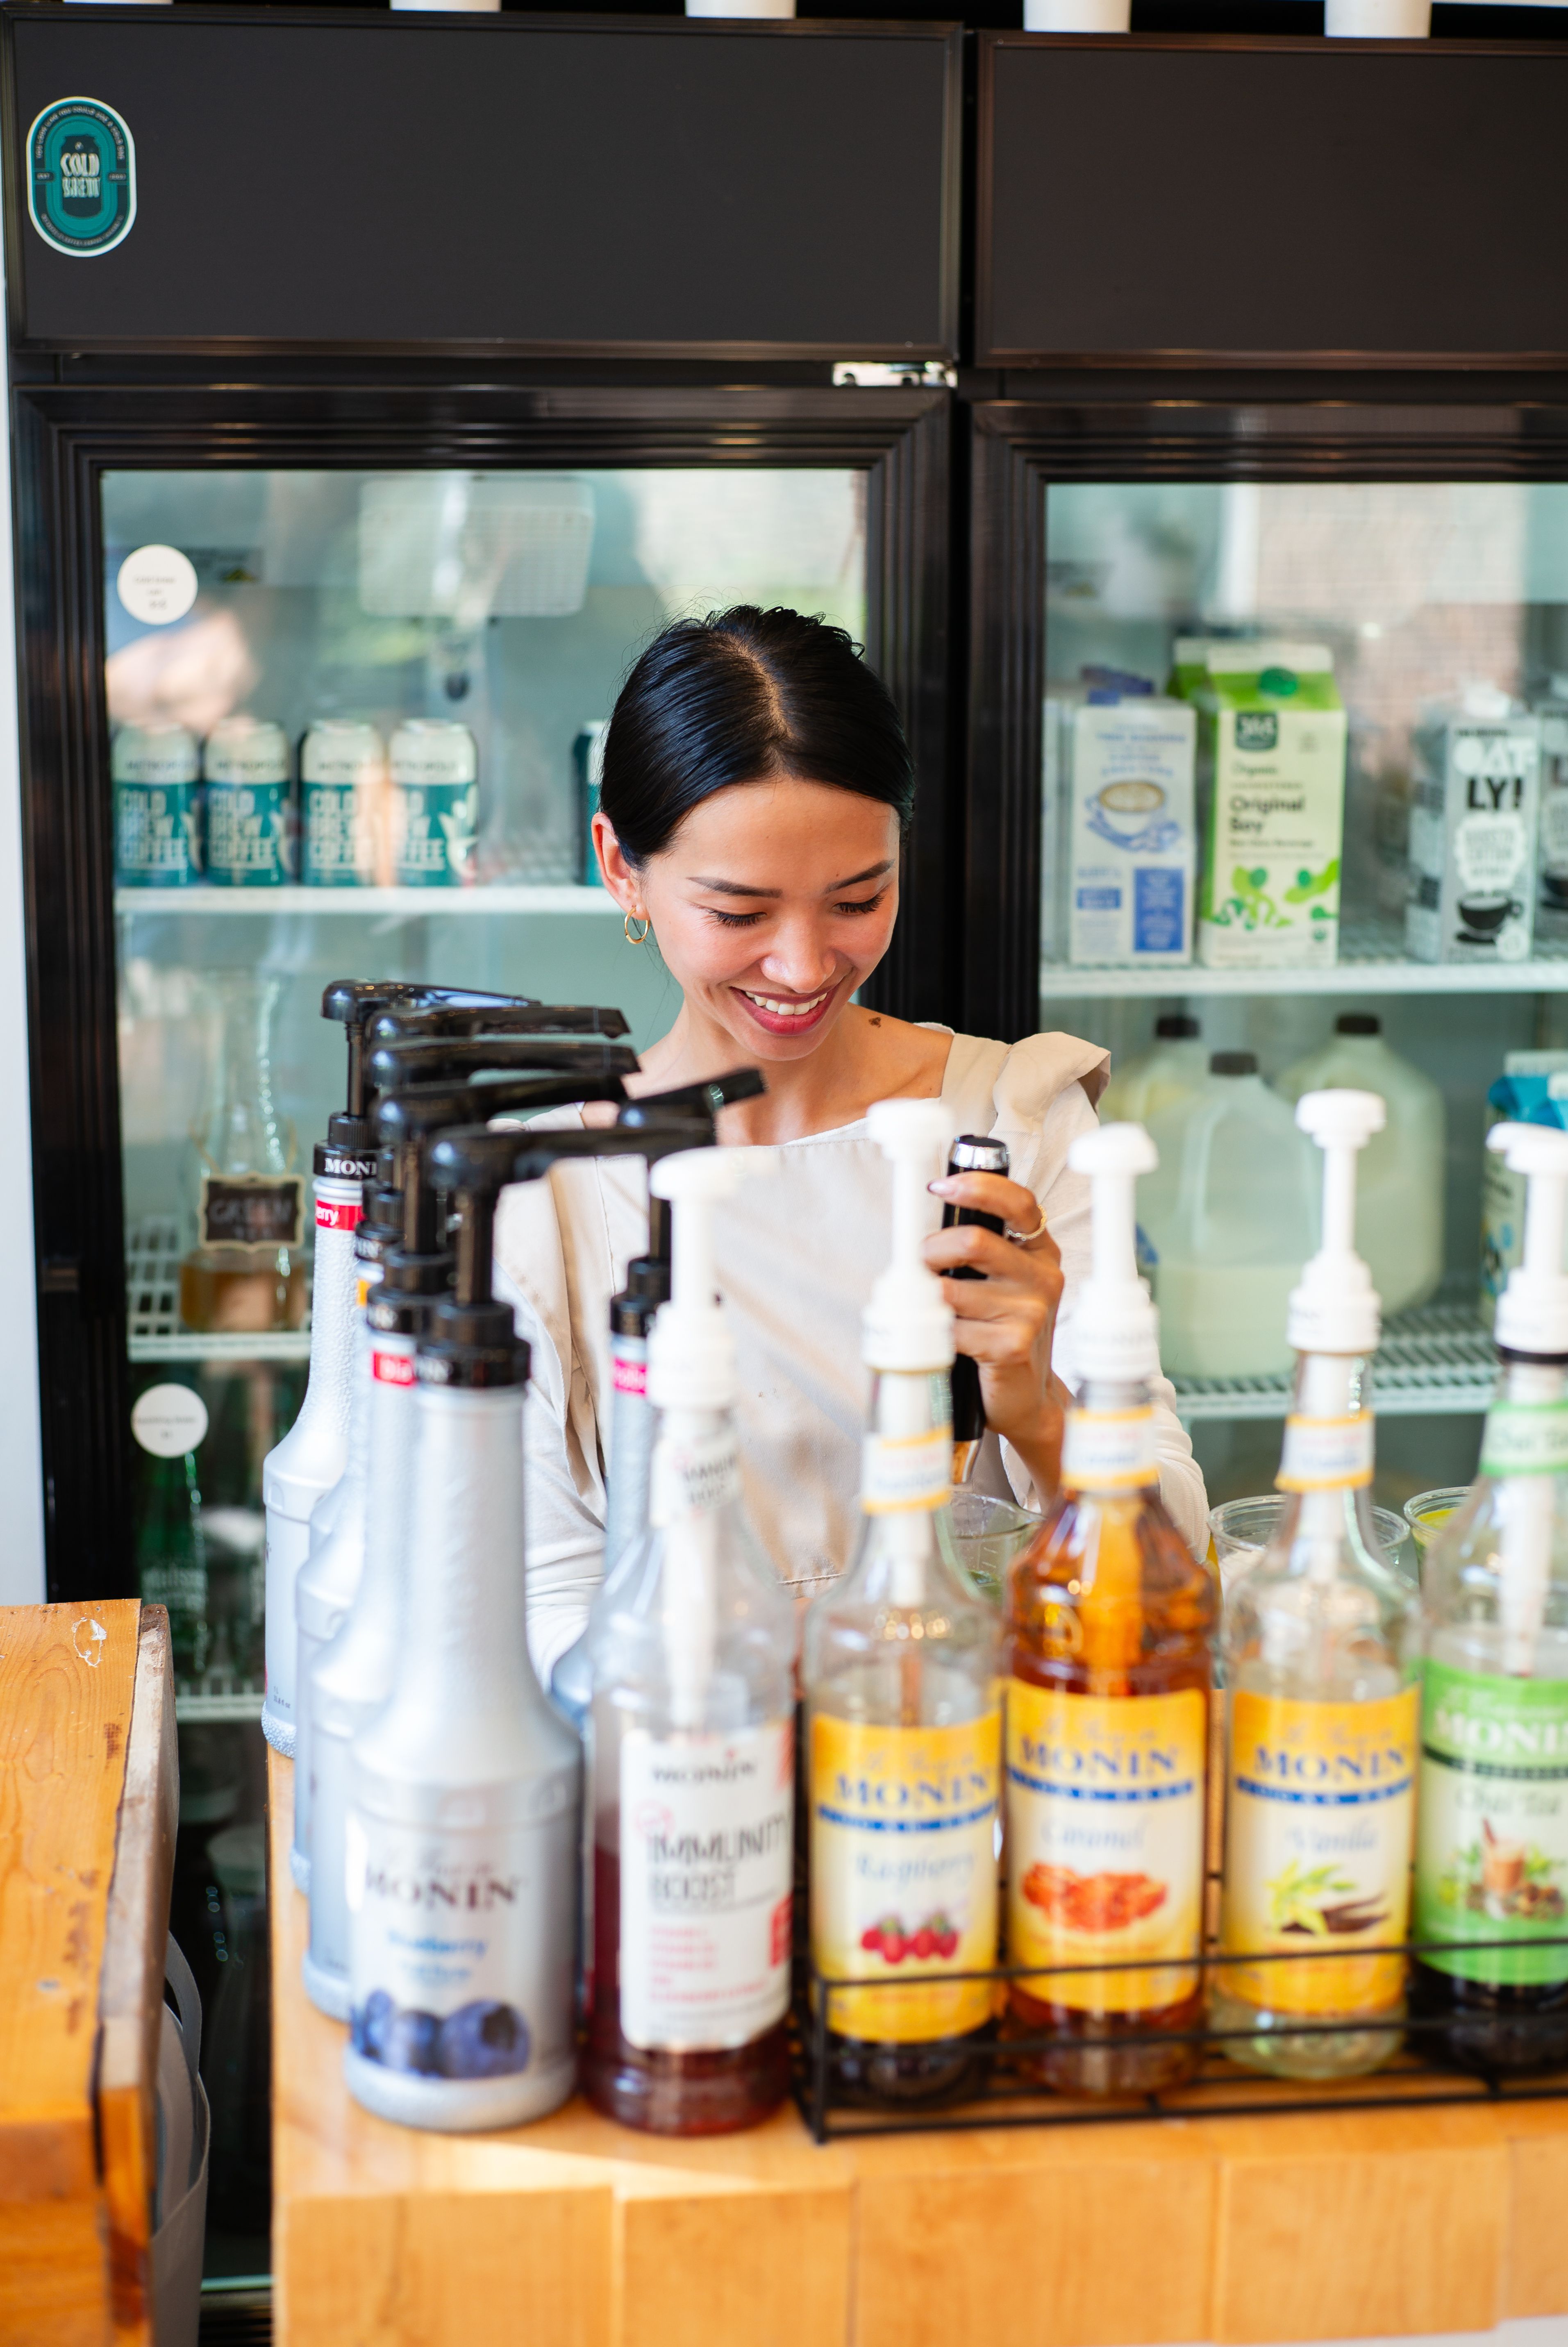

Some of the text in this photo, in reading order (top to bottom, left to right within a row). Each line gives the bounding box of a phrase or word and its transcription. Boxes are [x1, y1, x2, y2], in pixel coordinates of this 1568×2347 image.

[60, 153, 100, 177] COLD
[62, 177, 100, 198] BREW
[118, 789, 167, 816] COLD
[208, 789, 255, 816] COLD
[1229, 794, 1306, 816] Original
[1468, 778, 1523, 810] LY!
[118, 837, 187, 865] COFFEE
[209, 837, 277, 865] COFFEE
[324, 1157, 377, 1176] MONI
[1020, 1736, 1177, 1781] MONIN
[1253, 1745, 1405, 1781] MONIN
[835, 1770, 989, 1809] MONIN
[1040, 1813, 1150, 1851] Caramel
